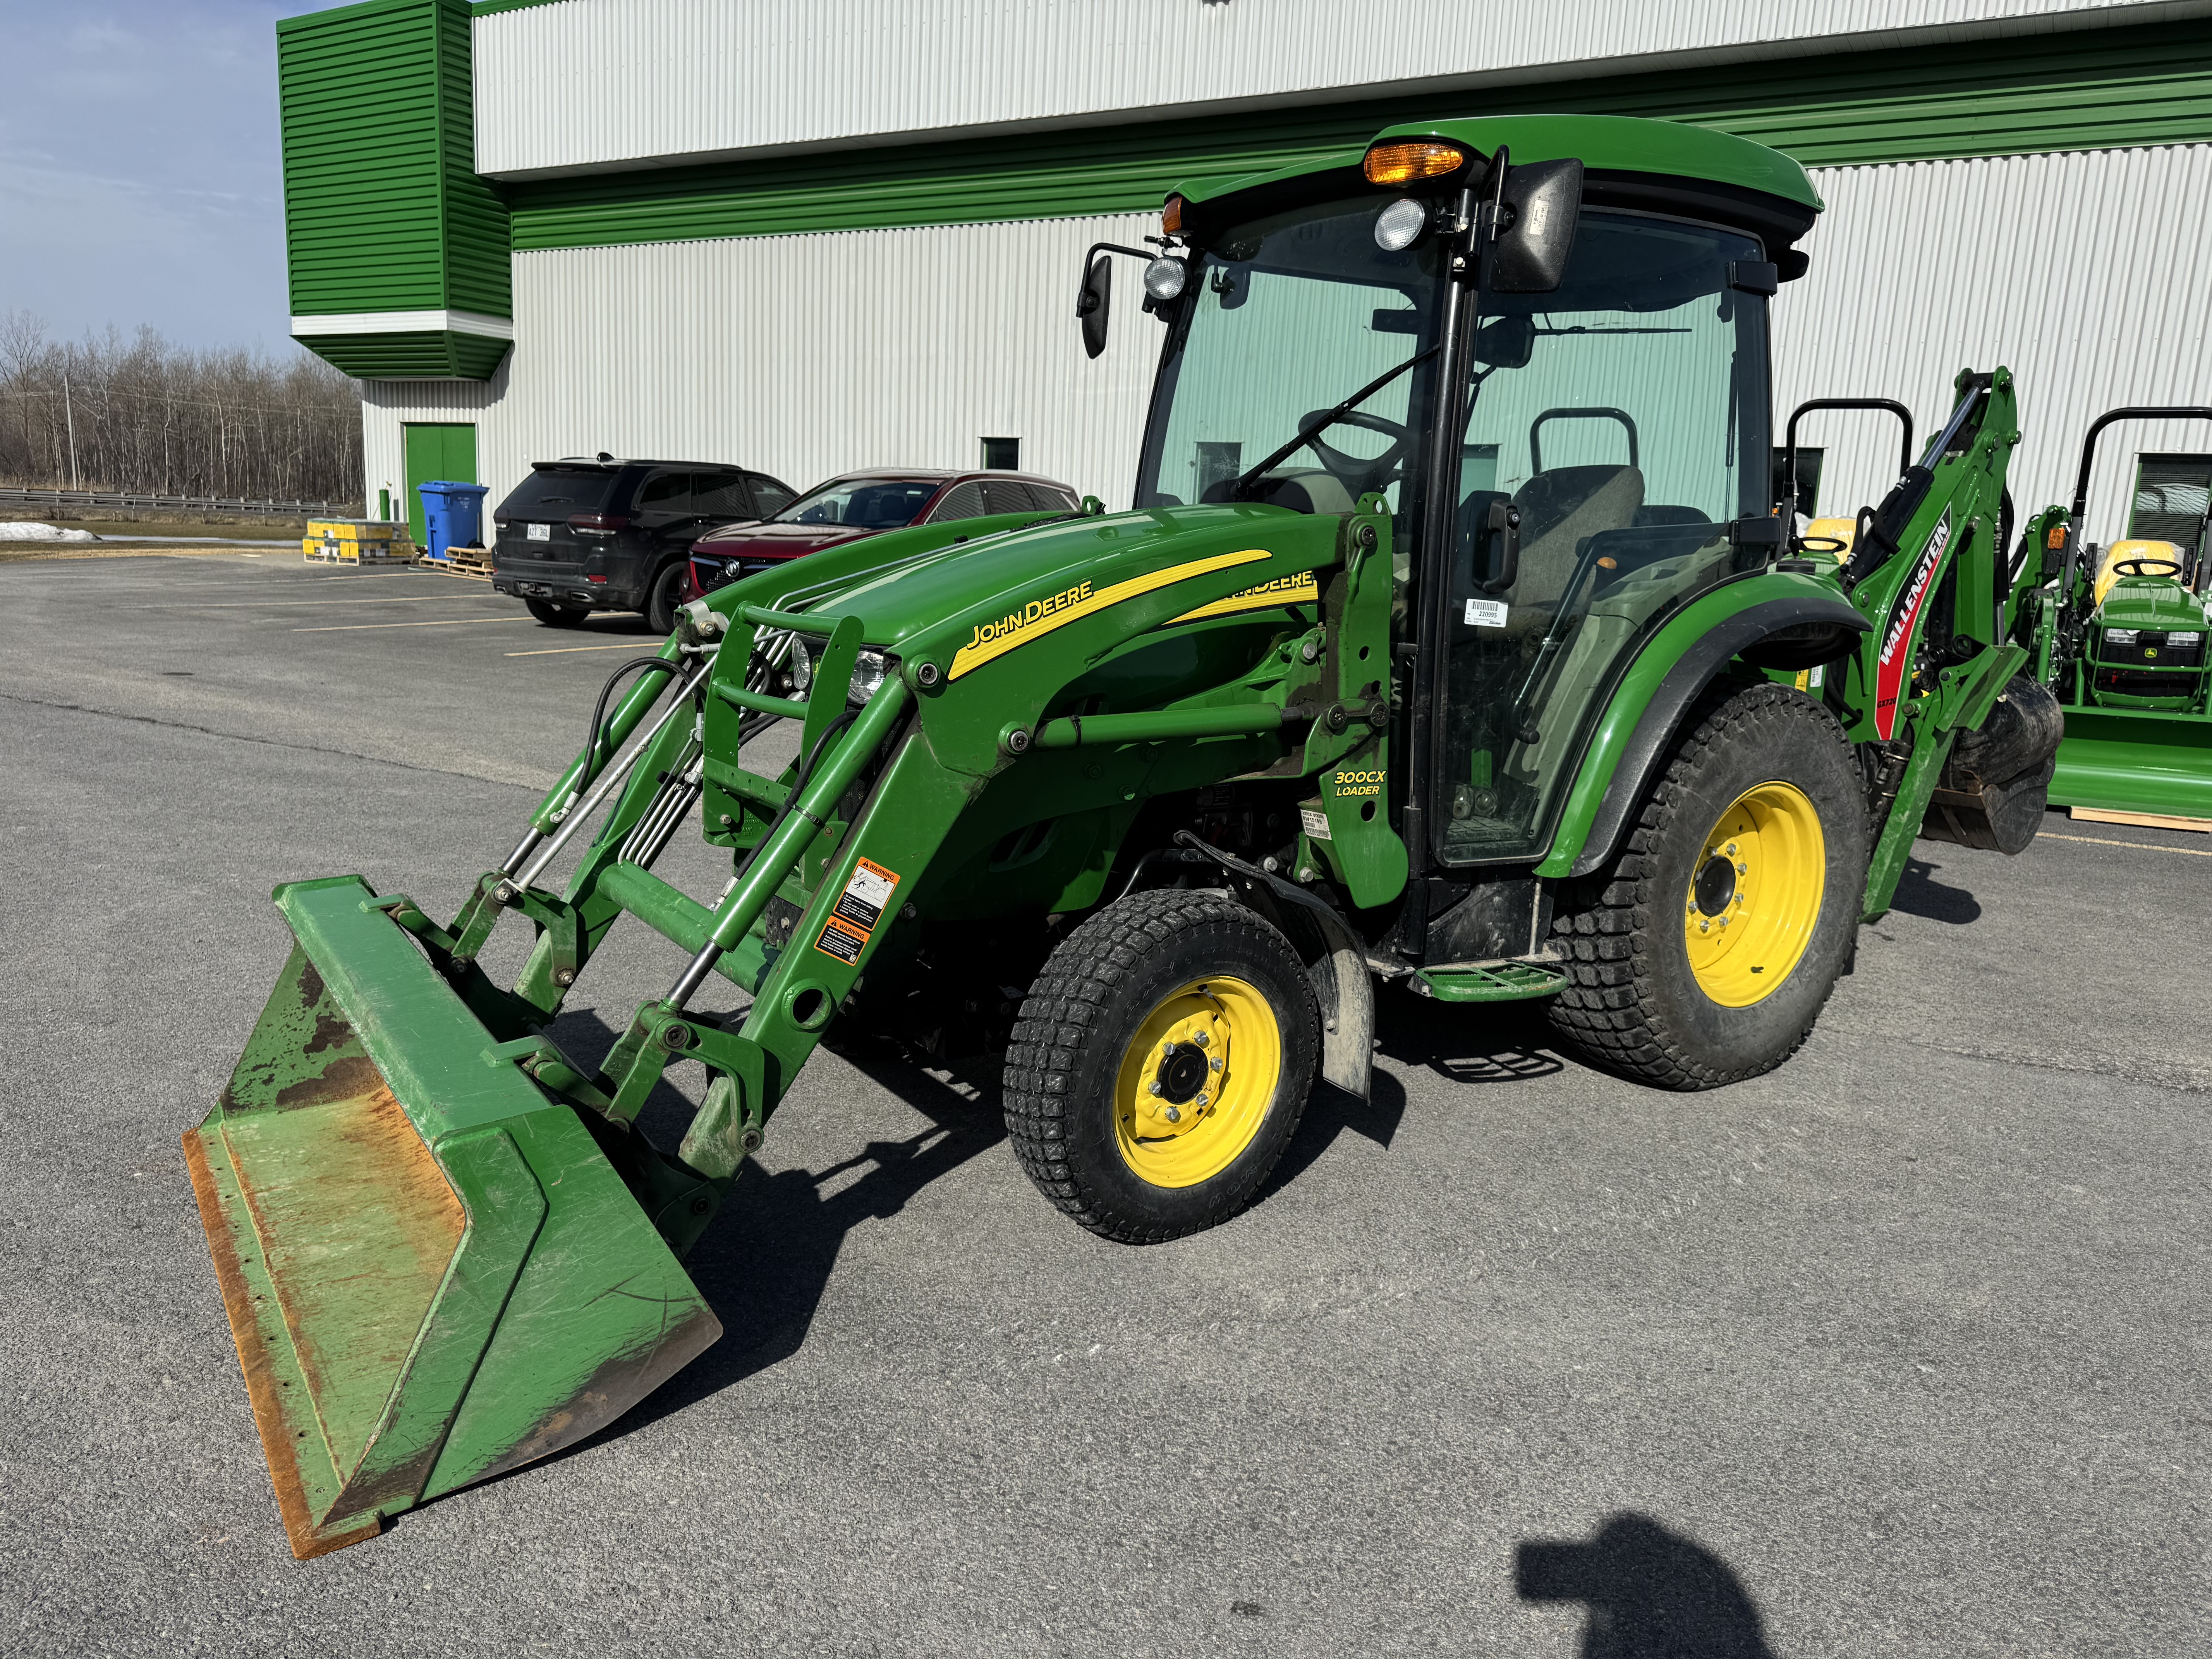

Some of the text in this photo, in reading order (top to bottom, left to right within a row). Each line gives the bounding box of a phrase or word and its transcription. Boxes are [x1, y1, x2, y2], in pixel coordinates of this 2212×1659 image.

[1880, 519, 1948, 666] WALLENSTEIN
[967, 580, 1093, 649] JOHN DEERE
[1877, 697, 1897, 709] GX720
[1334, 770, 1387, 784] 300CX
[1336, 786, 1380, 796] LOADER
[870, 864, 895, 880] WARNING
[839, 923, 865, 939] WARNING
[1090, 960, 1176, 1097] GALAXY
[1209, 1033, 1306, 1209] MIGHTY MOW
